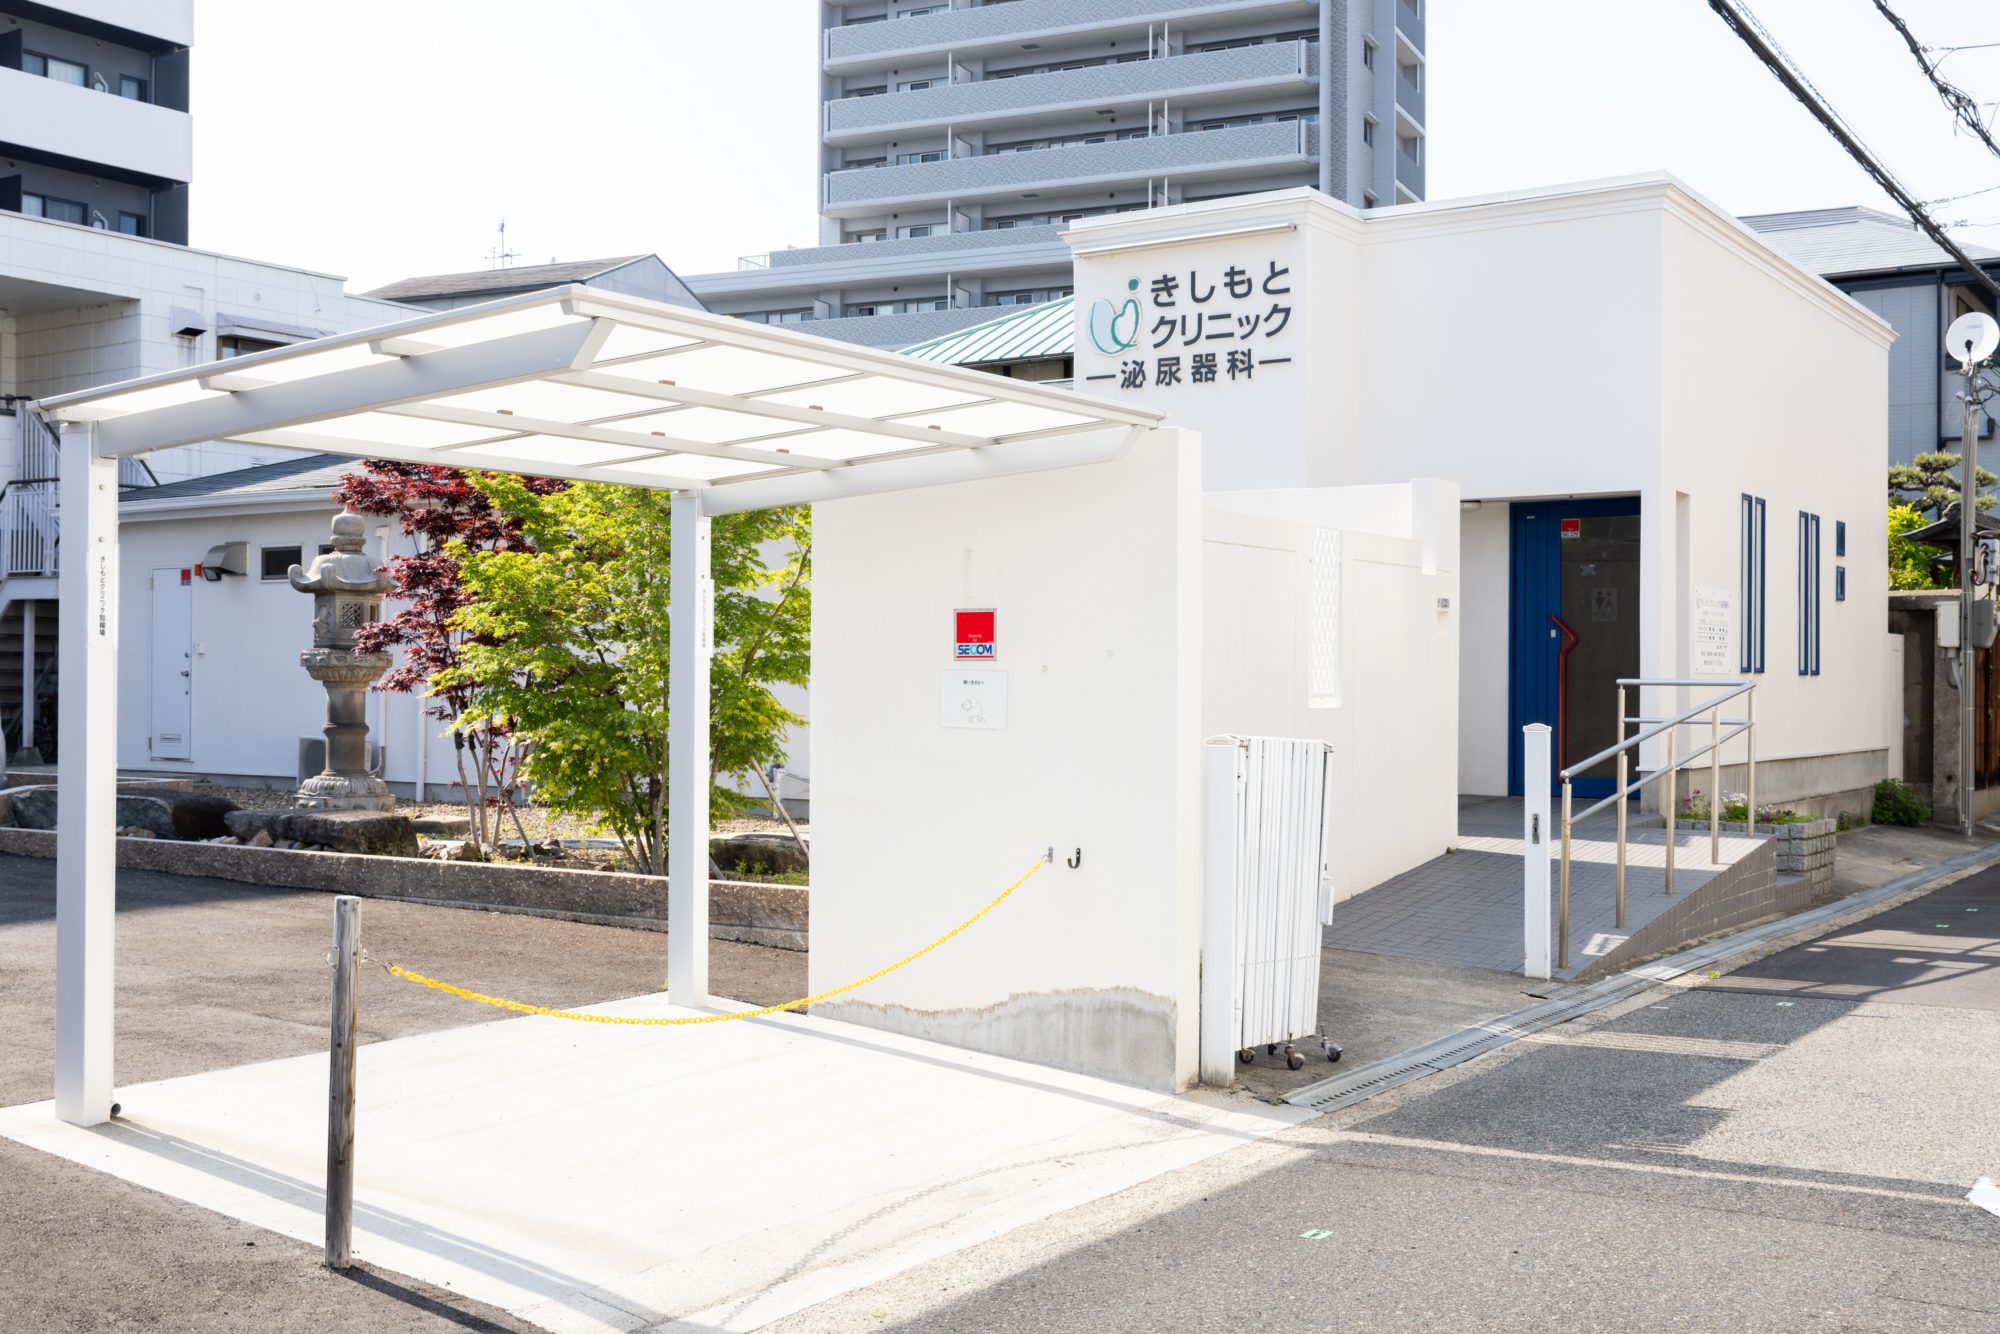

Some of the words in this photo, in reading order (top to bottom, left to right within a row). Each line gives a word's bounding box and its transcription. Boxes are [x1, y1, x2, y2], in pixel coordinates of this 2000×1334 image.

[1150, 260, 1291, 308] きしもと
[1150, 303, 1292, 349] クリニック
[958, 644, 993, 655] SECOM
